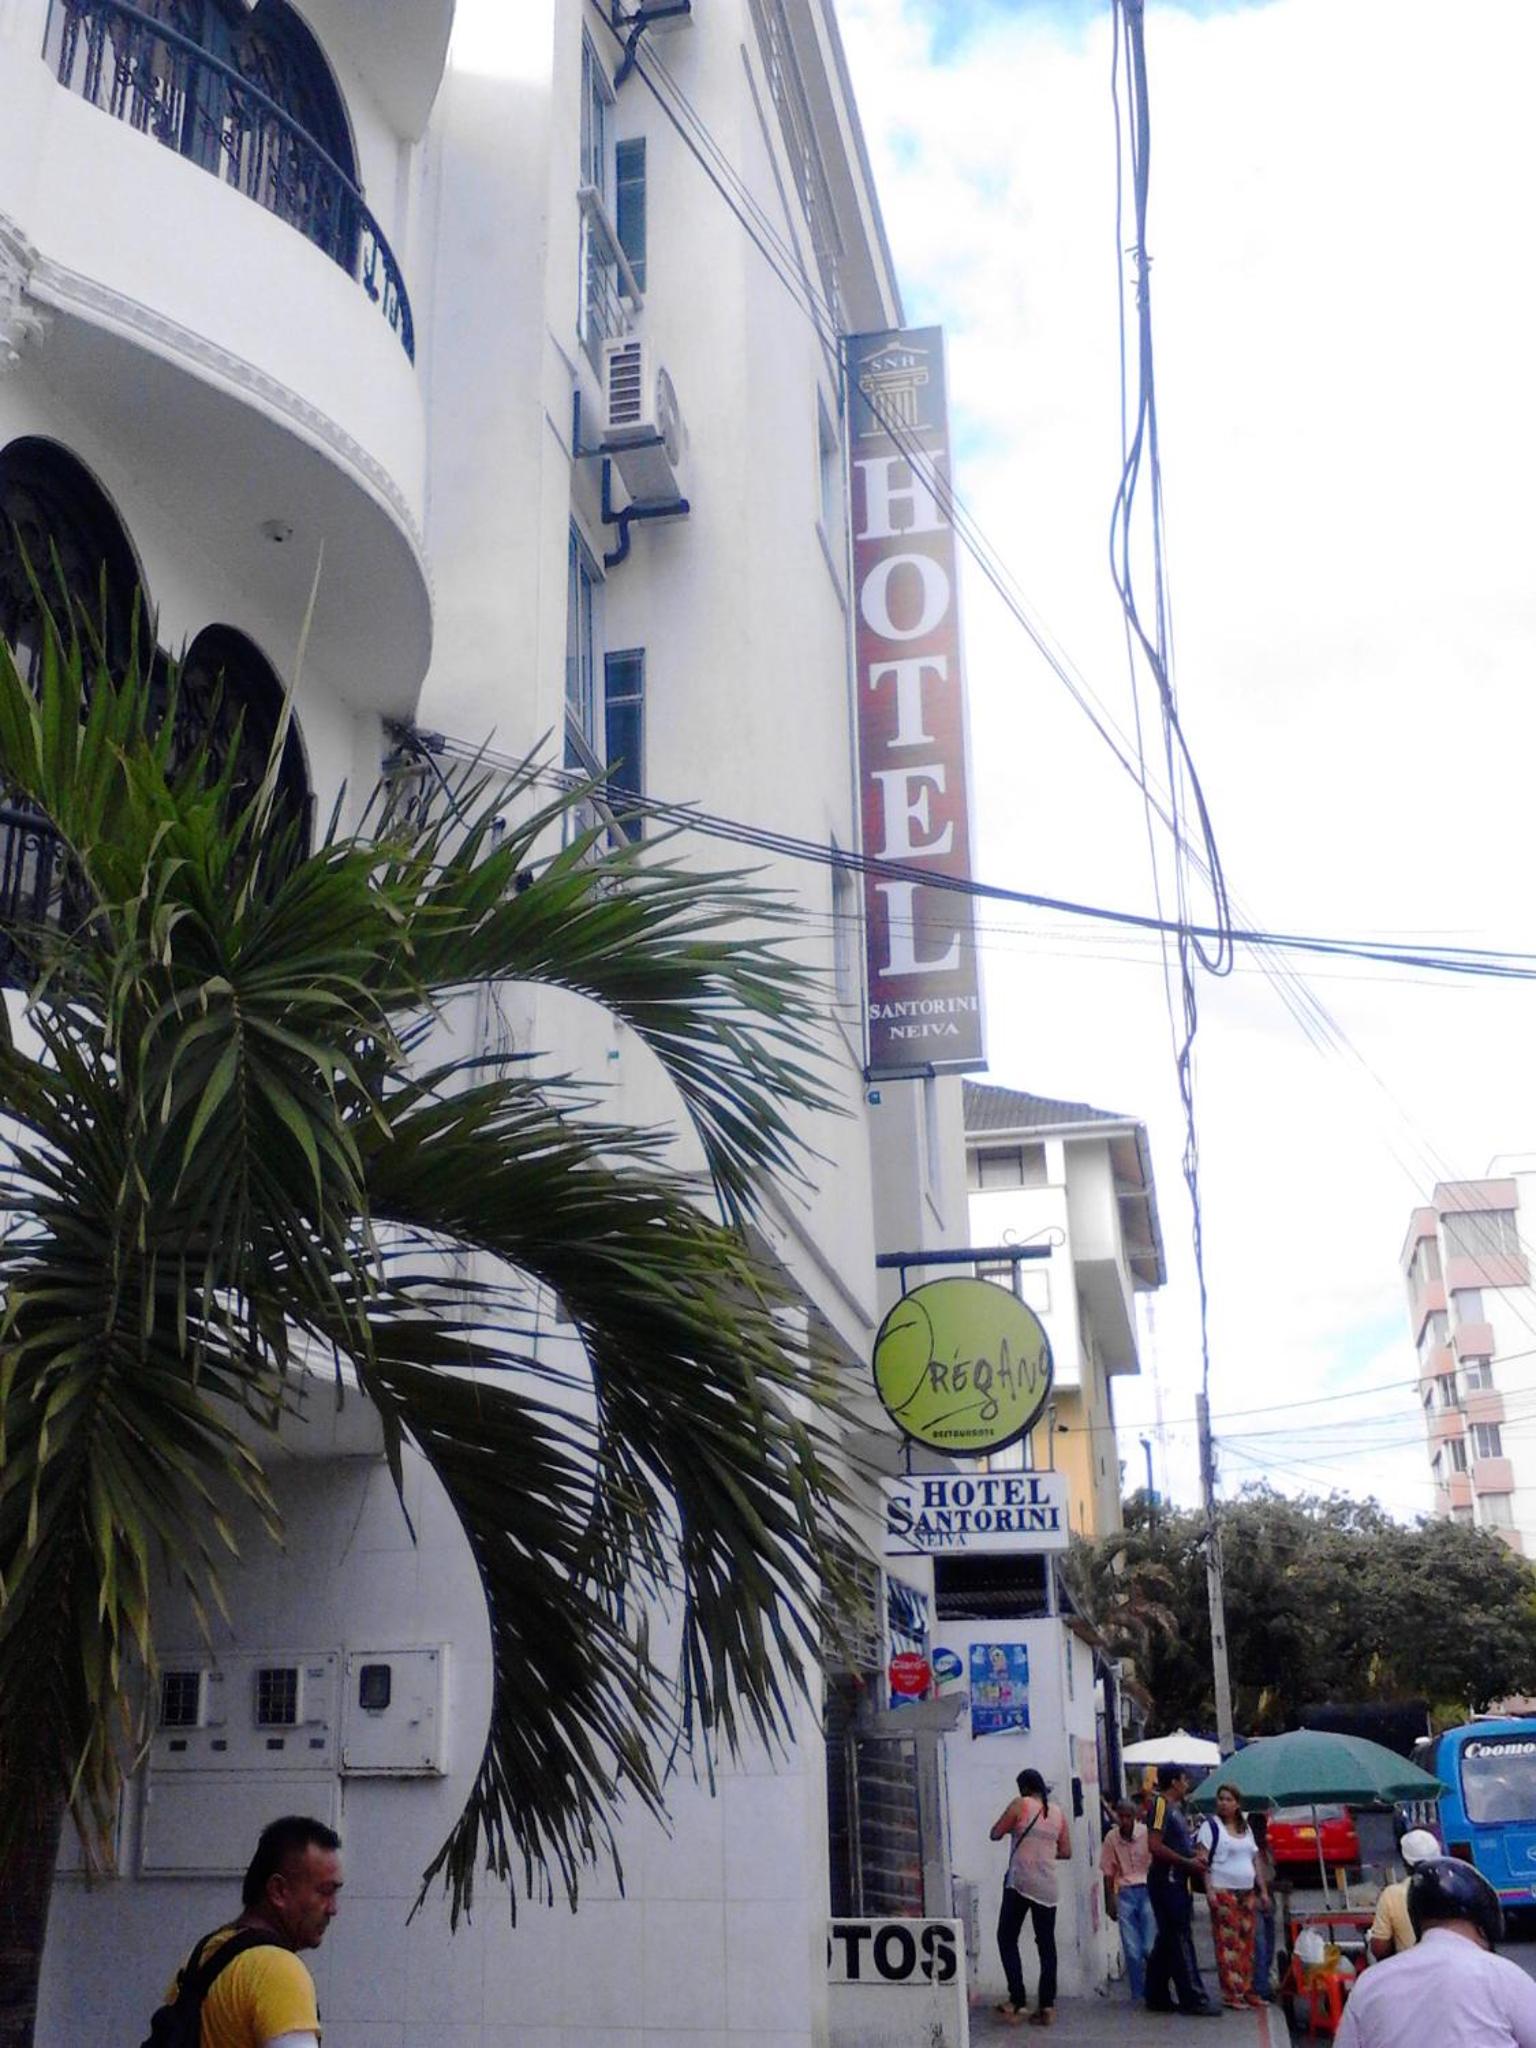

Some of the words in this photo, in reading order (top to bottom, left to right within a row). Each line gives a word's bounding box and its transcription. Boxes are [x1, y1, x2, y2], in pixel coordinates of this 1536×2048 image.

[870, 355, 915, 371] SNH
[853, 449, 962, 978] HOTEL
[868, 995, 979, 1021] SANTORINI
[888, 1021, 960, 1041] NEIVA
[922, 1478, 1051, 1508] HOTEL
[887, 1497, 1060, 1536] SANTORINI
[914, 1531, 967, 1547] NEIVA
[827, 1924, 957, 1981] TOS
